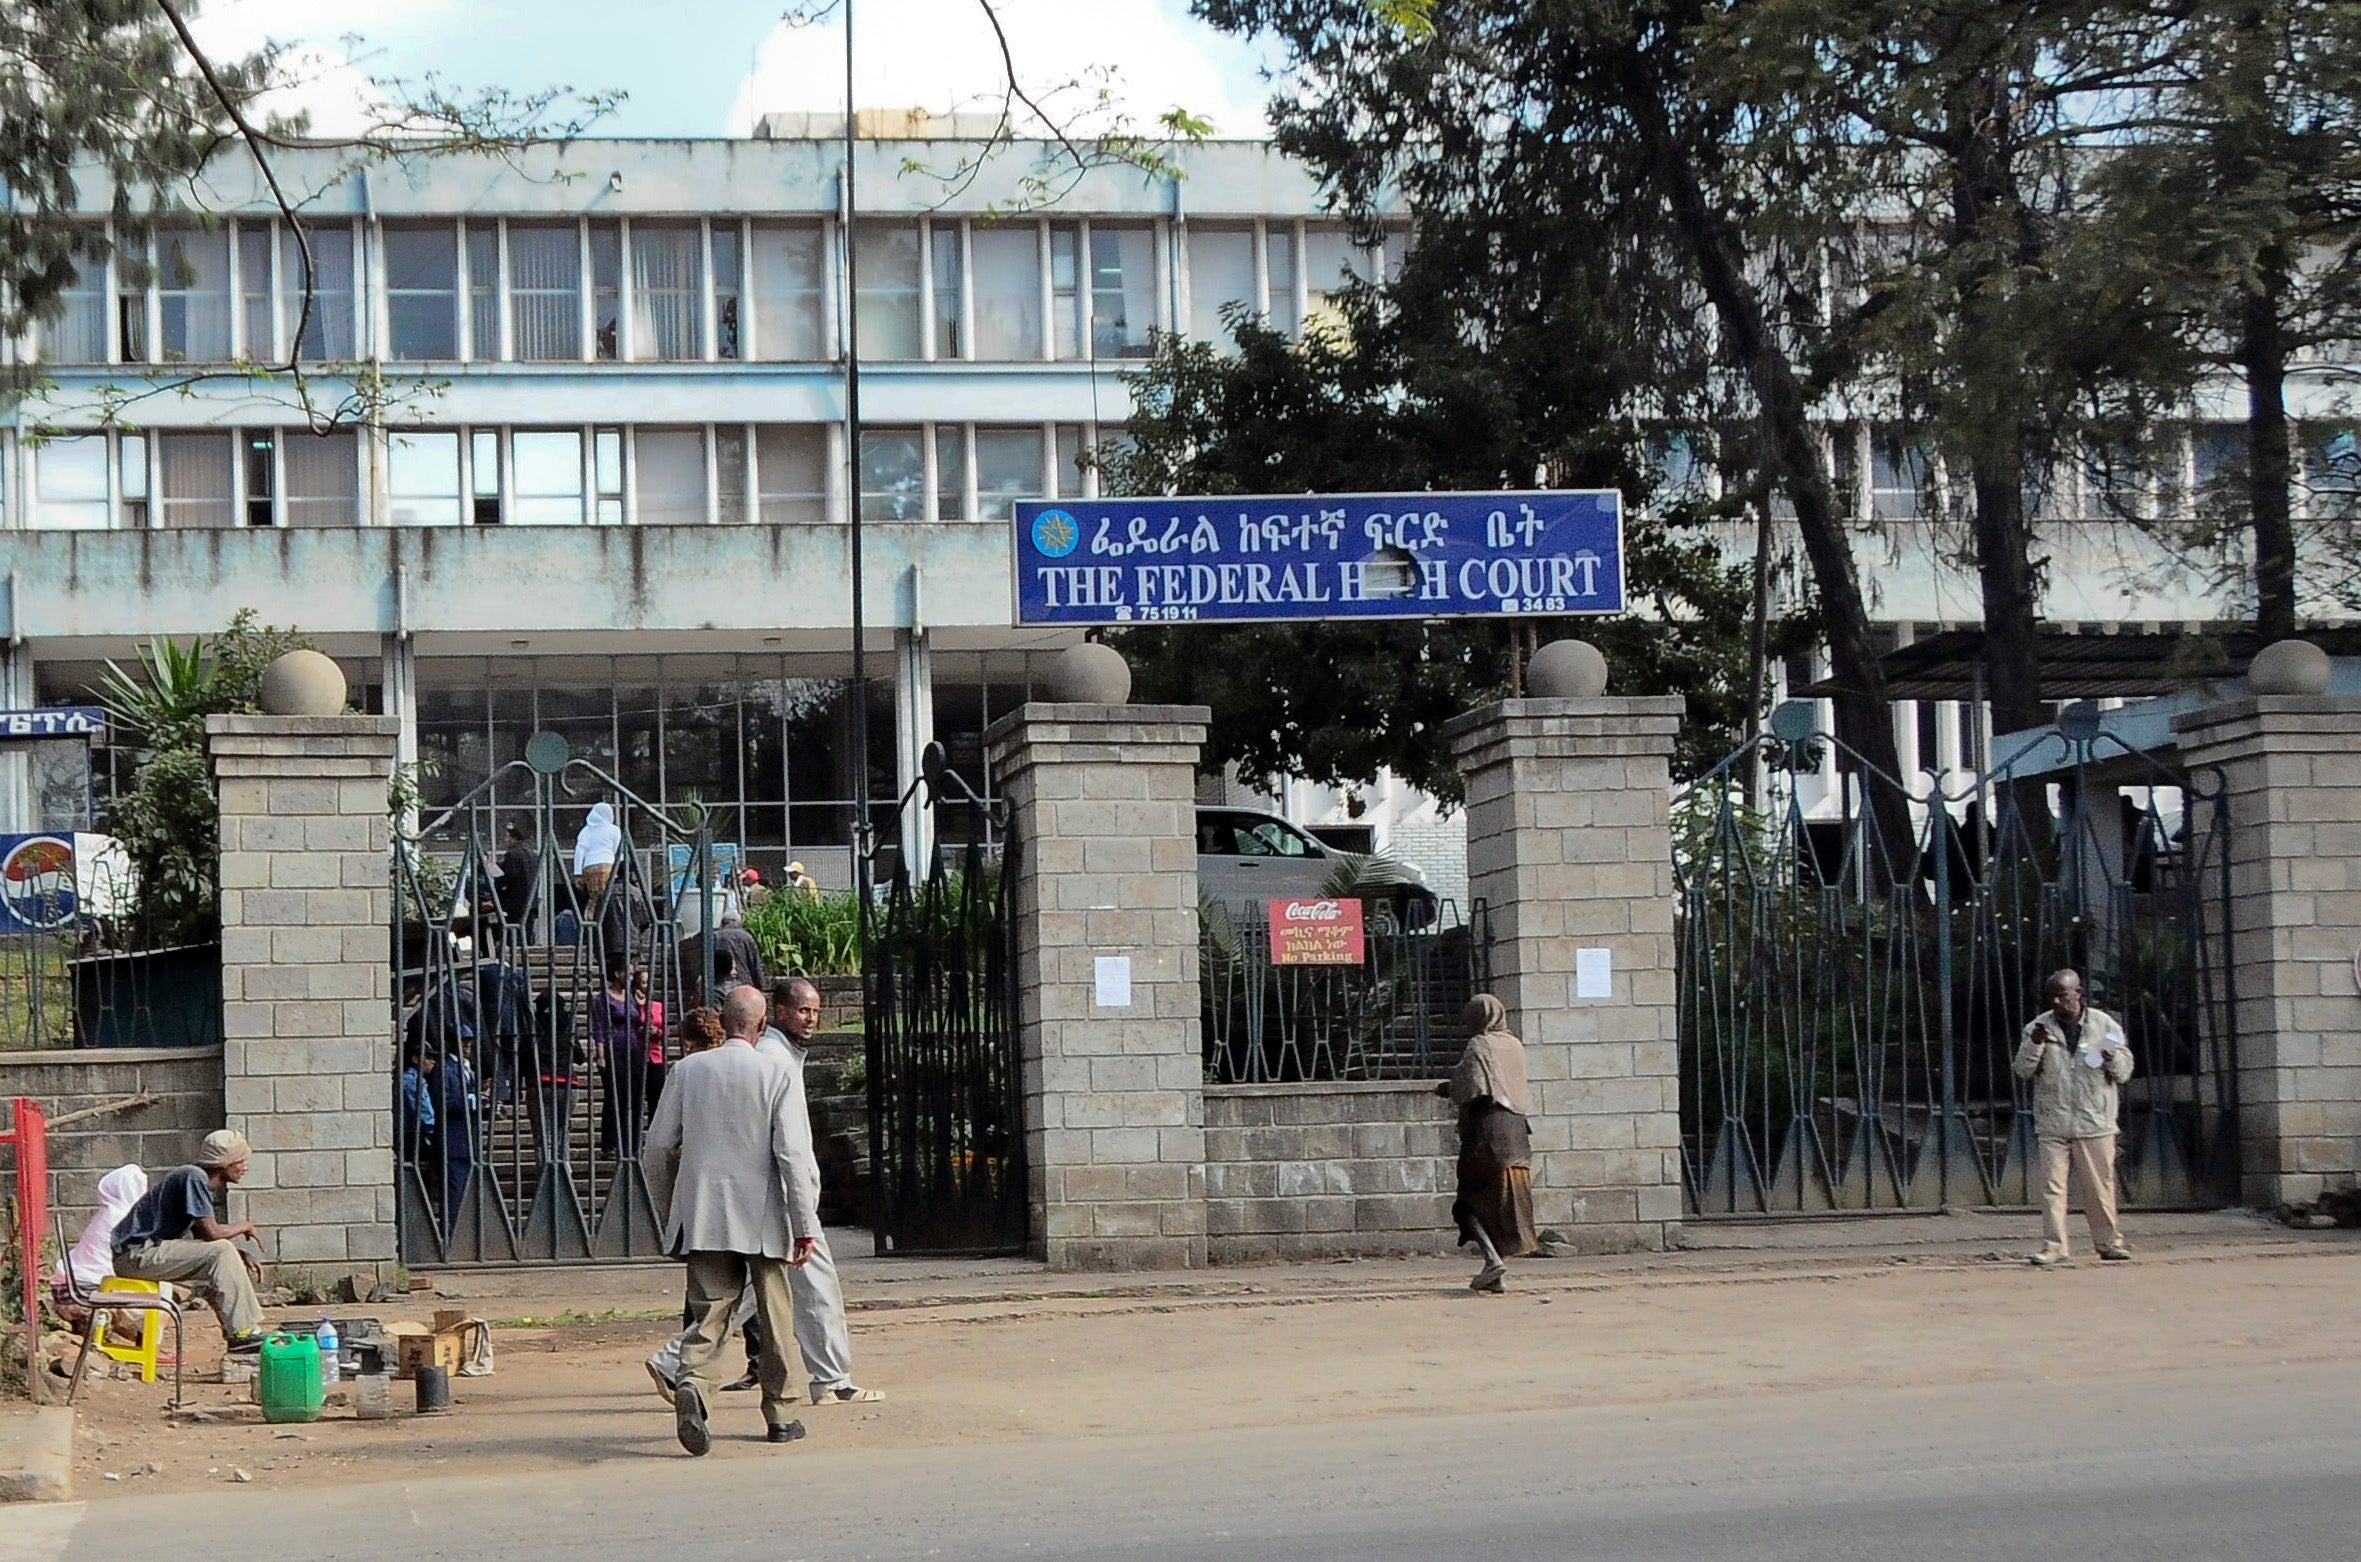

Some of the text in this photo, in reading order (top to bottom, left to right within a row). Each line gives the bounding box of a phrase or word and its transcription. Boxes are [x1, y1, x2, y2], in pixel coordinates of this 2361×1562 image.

[1091, 503, 1544, 556] ፌዴራል ከፍተኛ ፍርድ ቤት
[1037, 557, 1601, 606] THE FEDERAL HH COURT
[1281, 950, 1354, 964] No Parking
